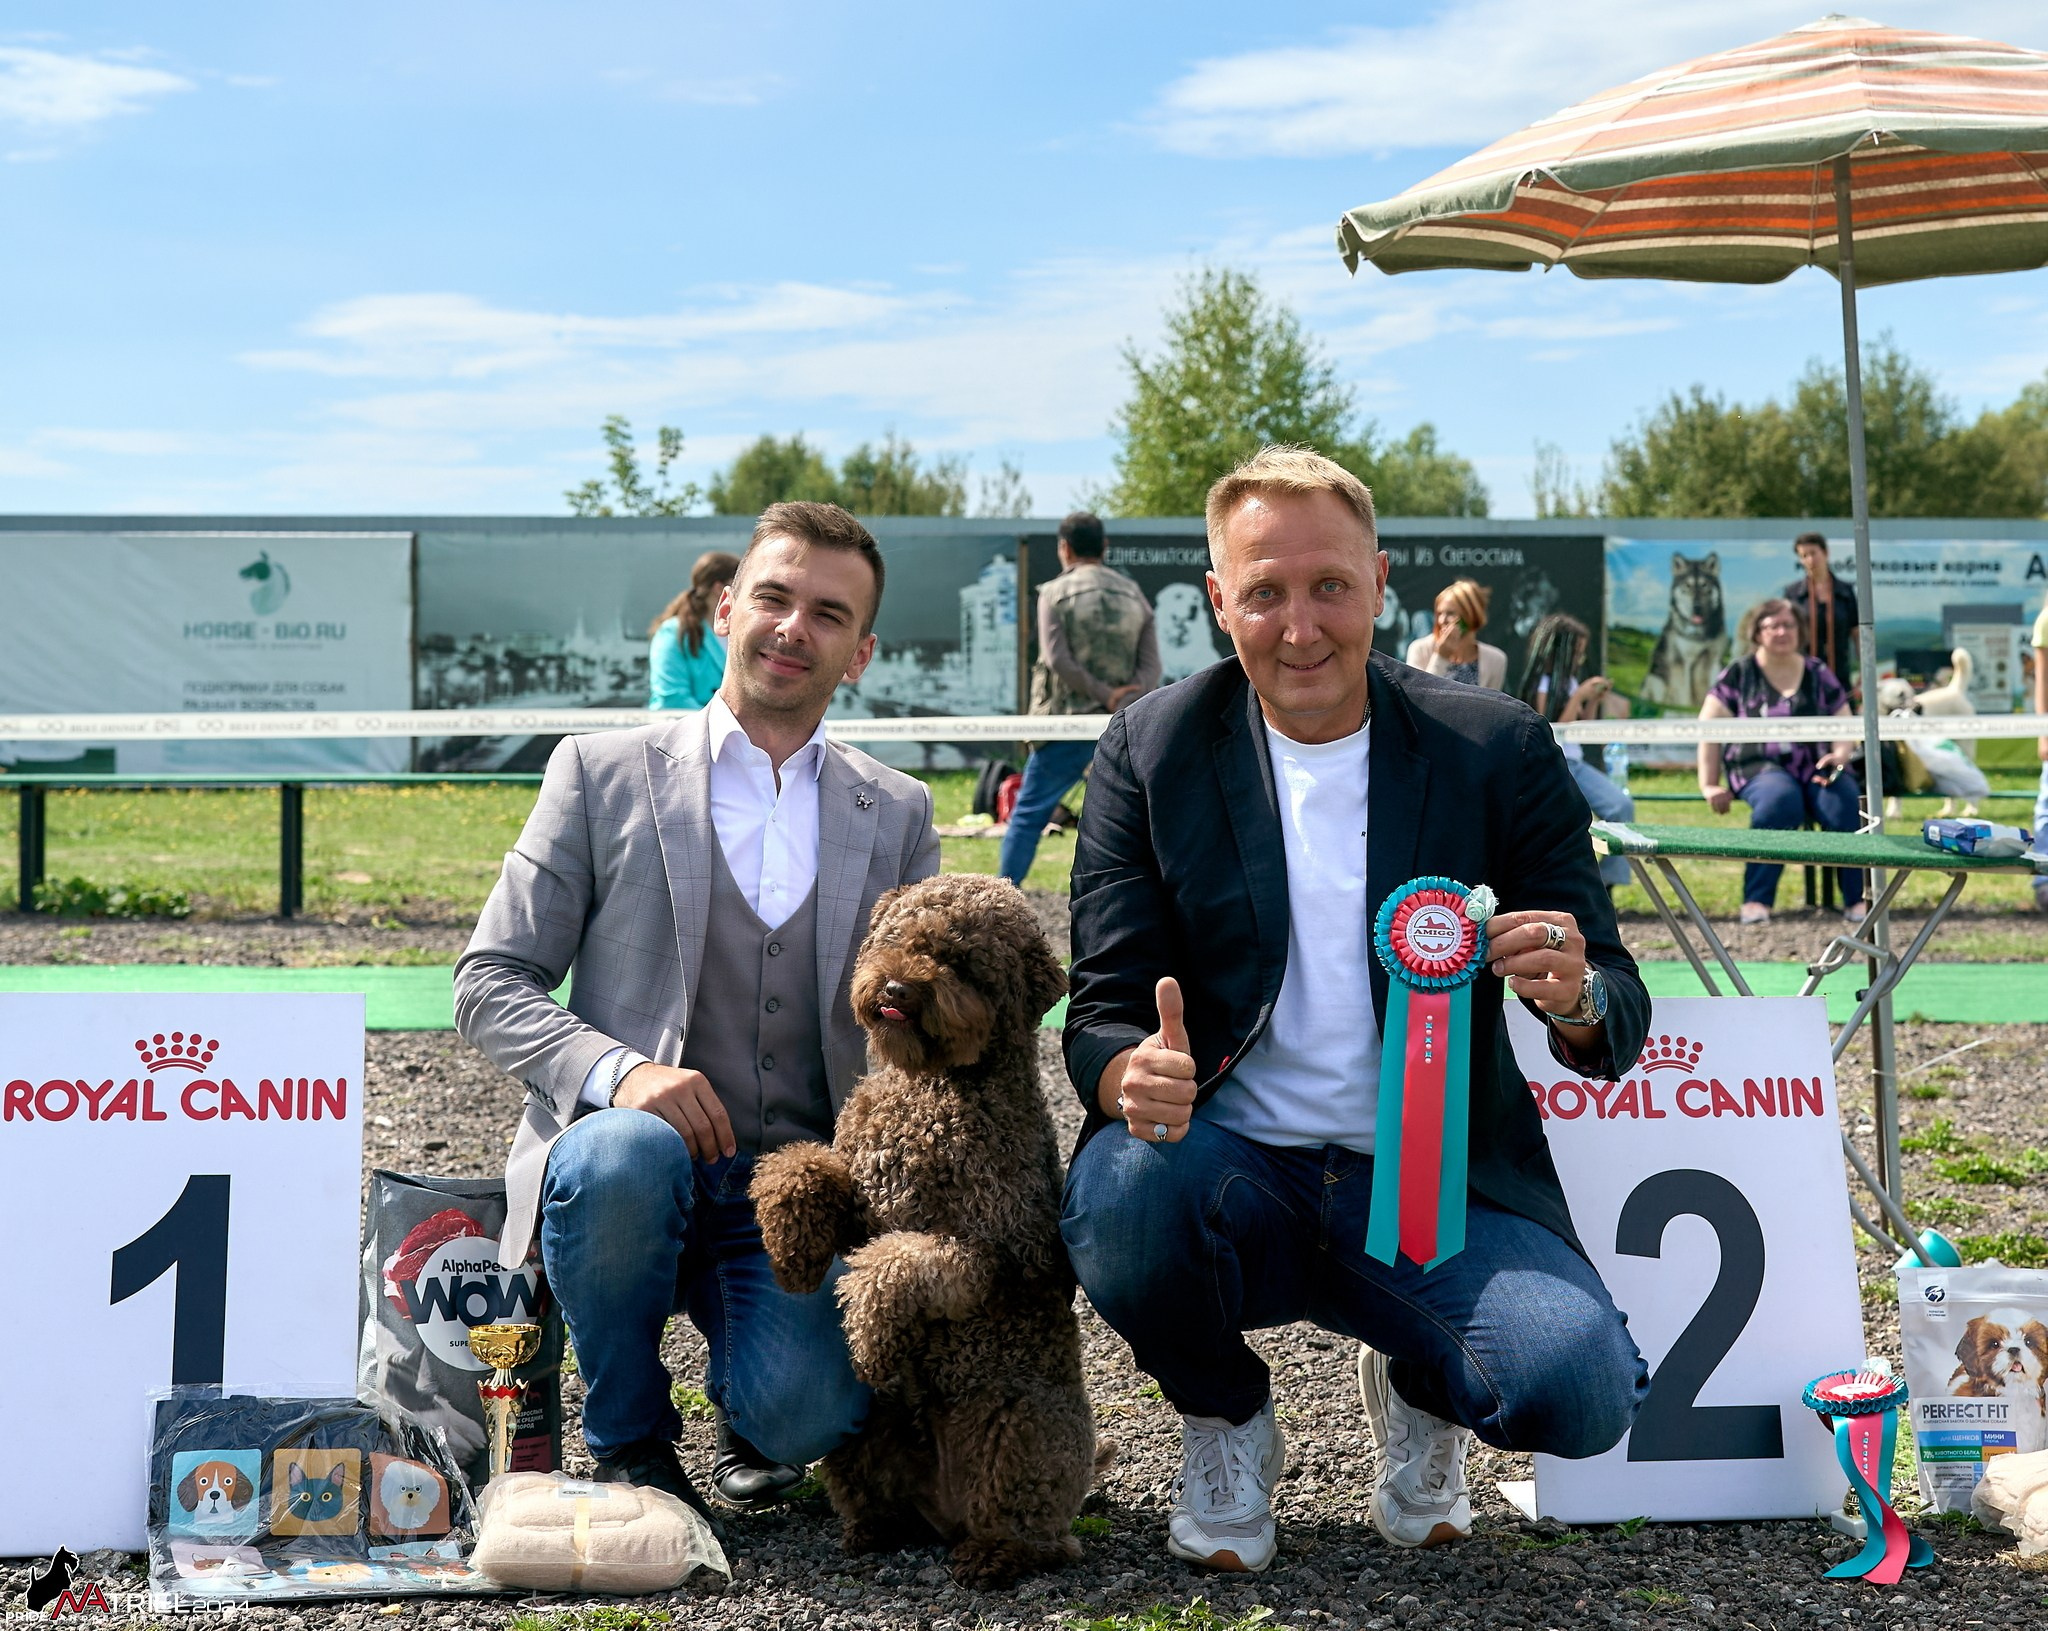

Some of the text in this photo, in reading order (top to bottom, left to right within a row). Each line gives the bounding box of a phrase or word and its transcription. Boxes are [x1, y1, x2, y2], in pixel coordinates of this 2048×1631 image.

[1103, 547, 1210, 566] ЕДНЕАЗИАТСКИЕ
[183, 622, 256, 640] HORSE
[1414, 929, 1455, 937] AMIGO
[3, 1077, 347, 1122] ROYAL CANIN
[1676, 1076, 1824, 1119] CANIN
[110, 1174, 231, 1400] 1
[1615, 1168, 1785, 1462] 2
[449, 1340, 469, 1348] SUPE
[1922, 1404, 2009, 1419] PERFECT FIT
